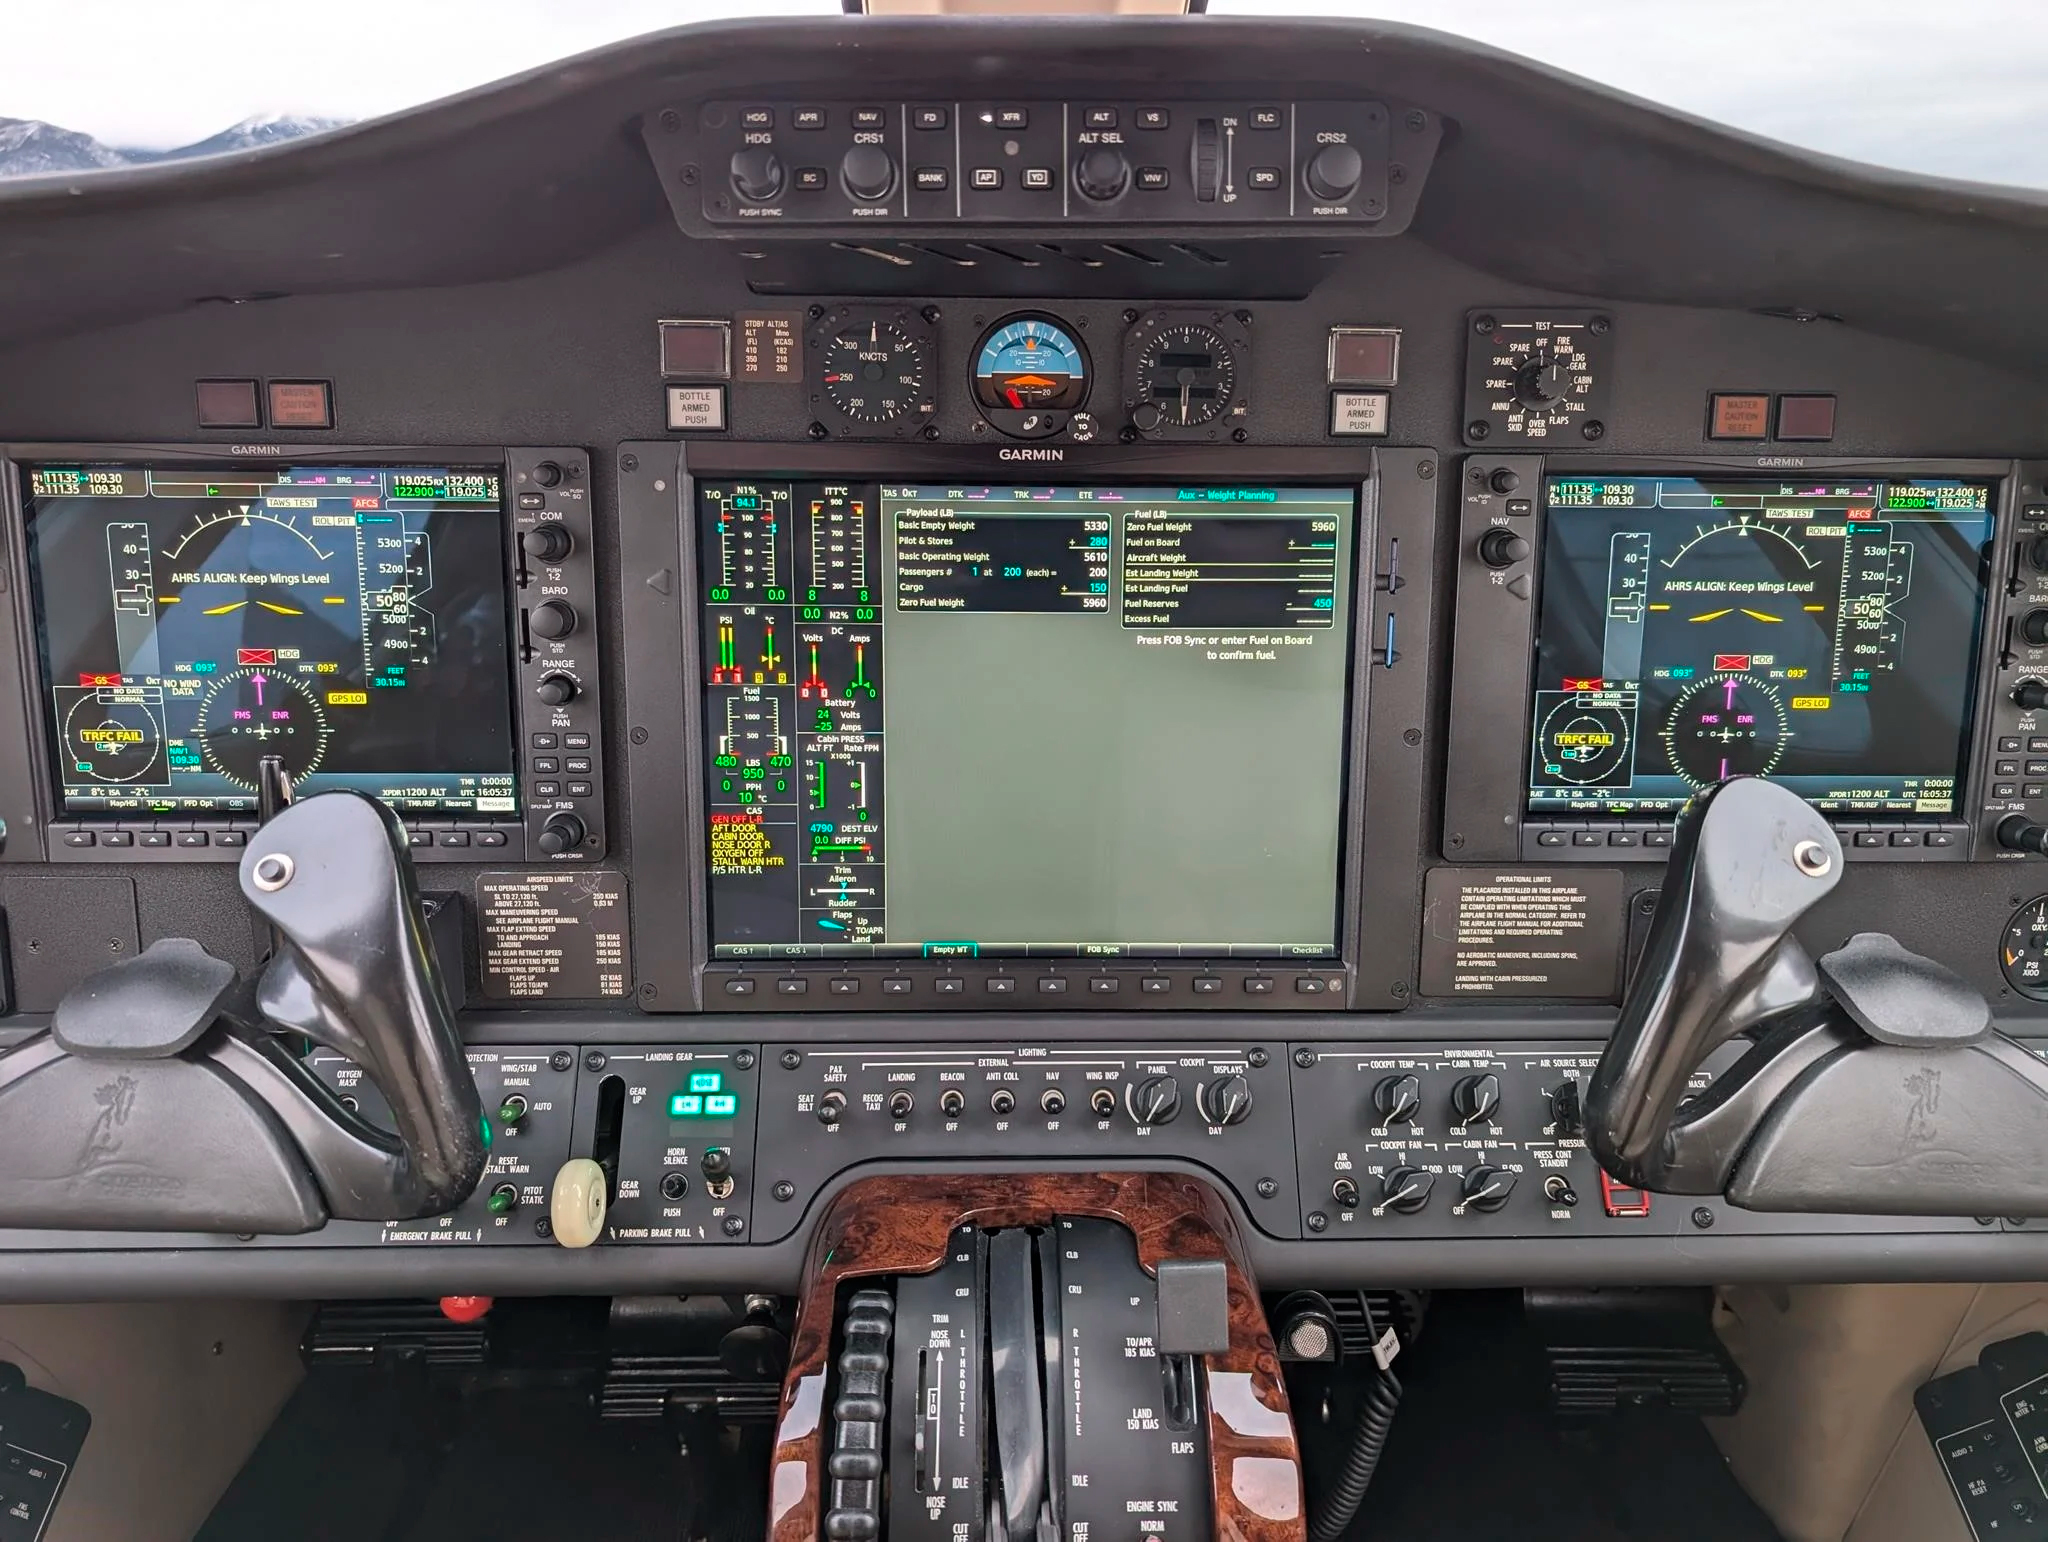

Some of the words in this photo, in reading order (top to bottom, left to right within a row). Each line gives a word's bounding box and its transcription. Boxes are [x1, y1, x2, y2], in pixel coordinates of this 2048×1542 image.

[746, 113, 767, 121] HDG
[1094, 113, 1109, 121] ALT
[745, 134, 772, 144] HDG
[854, 133, 884, 144] CRS1
[1079, 133, 1098, 143] ALT
[1101, 133, 1124, 143] SEL
[1316, 133, 1347, 143] CRS2
[919, 174, 942, 182] BANK
[980, 174, 992, 182] AP
[1536, 322, 1550, 330] TEST
[1557, 337, 1570, 345] FIRE
[844, 342, 857, 350] 300
[1510, 344, 1530, 352] SPARE
[1570, 362, 1586, 370] GEAR
[1574, 376, 1592, 384] CABIN
[680, 392, 710, 400] BOTTLE
[882, 400, 894, 408] 150
[1346, 398, 1376, 406] BOTTLE
[682, 404, 709, 412] ARMED
[1566, 403, 1585, 411] STALL
[1074, 413, 1090, 421] PULL
[1347, 410, 1374, 418] ARMED
[685, 416, 707, 424] PUSH
[1508, 415, 1523, 423] ANTI
[1549, 416, 1568, 424] FLAPS
[1350, 422, 1370, 430] PUSH
[1508, 423, 1522, 431] SKID
[1529, 420, 1545, 428] OVER
[1074, 432, 1093, 440] CAGE
[1527, 428, 1546, 436] SPEED
[232, 446, 280, 454] GARMIN
[1000, 449, 1063, 461] GARMIN
[1757, 458, 1803, 466] GARMIN
[88, 474, 122, 483] 109.30
[394, 476, 433, 485] 119.025
[444, 476, 483, 486] 132.400
[47, 485, 80, 494] 111.35
[395, 487, 434, 497] 122.900
[1603, 486, 1634, 494] 109.30
[1207, 491, 1235, 500] Weight
[1239, 491, 1275, 501] Planning
[355, 499, 378, 507] AFCS
[737, 499, 755, 507] 94.1
[540, 512, 562, 520] COM
[899, 521, 919, 530] Basic
[921, 522, 945, 531] Empty
[949, 521, 975, 530] Weight
[1084, 522, 1108, 530] 5330
[1312, 522, 1335, 531] 5960
[899, 537, 917, 545] Pilot
[919, 537, 925, 545] &
[927, 537, 953, 545] Stores
[1864, 547, 1887, 556] 5300
[379, 564, 403, 573] 5200
[172, 574, 200, 582] AHRS
[203, 573, 237, 583] ALIGN:
[240, 573, 267, 584] Keep
[270, 574, 299, 585] Wings
[302, 574, 329, 584] Level
[900, 583, 924, 592] Cargo
[1090, 583, 1106, 592] 150
[1083, 599, 1106, 607] 5960
[1137, 636, 1161, 645] Press
[1164, 636, 1182, 644] FOB
[1184, 636, 1206, 647] Sync
[1208, 637, 1218, 645] or
[1221, 637, 1246, 645] enter
[1250, 636, 1268, 645] Fuel
[1271, 637, 1282, 645] on
[1285, 636, 1312, 645] Board
[1207, 651, 1217, 660] to
[1219, 651, 1253, 660] confirm
[1256, 651, 1276, 660] fuel.
[543, 660, 575, 668] RANGE
[234, 711, 251, 719] FMS
[272, 711, 289, 719] ENR
[552, 719, 570, 727] PAN
[83, 731, 114, 740] TRFC
[117, 731, 141, 740] FAIL
[1558, 734, 1586, 744] TRFC
[1588, 734, 1611, 744] FAIL
[743, 769, 764, 778] 950
[478, 789, 512, 797] 16:05:37
[446, 800, 472, 808] Nearest
[482, 800, 510, 809] Message
[1444, 1050, 1494, 1058] ENVIRONMENTAL
[978, 1059, 1009, 1067] EXTERNAL
[1452, 1060, 1469, 1068] CABIN
[1471, 1060, 1489, 1068] TEMP
[1148, 1066, 1168, 1074] PANEL
[1214, 1066, 1243, 1074] DISPLAYS
[888, 1073, 916, 1081] LANDING
[940, 1073, 964, 1081] BEACON
[1086, 1072, 1103, 1080] WING
[1105, 1072, 1119, 1080] INSP
[863, 1094, 883, 1103] RECOG
[866, 1102, 881, 1111] TAXI
[1137, 1127, 1151, 1135] DAY
[1371, 1128, 1387, 1136] COLD
[667, 1148, 685, 1156] HORN
[1540, 1159, 1568, 1168] STANDBY
[521, 1196, 544, 1204] STATIC
[390, 1232, 428, 1240] EMERGENCY
[431, 1232, 452, 1240] BRAKE
[456, 1232, 471, 1240] PULL
[619, 1229, 648, 1237] PARKING
[651, 1229, 672, 1237] BRAKE
[1133, 1408, 1152, 1419] LAND
[1127, 1419, 1139, 1430] 150
[1142, 1419, 1159, 1430] KIAS
[1171, 1442, 1194, 1454] FLAPS
[952, 1477, 968, 1489] IDLE
[1127, 1501, 1155, 1512] ENGINE
[1157, 1501, 1178, 1512] SYNC
[1141, 1520, 1164, 1532] NORM
